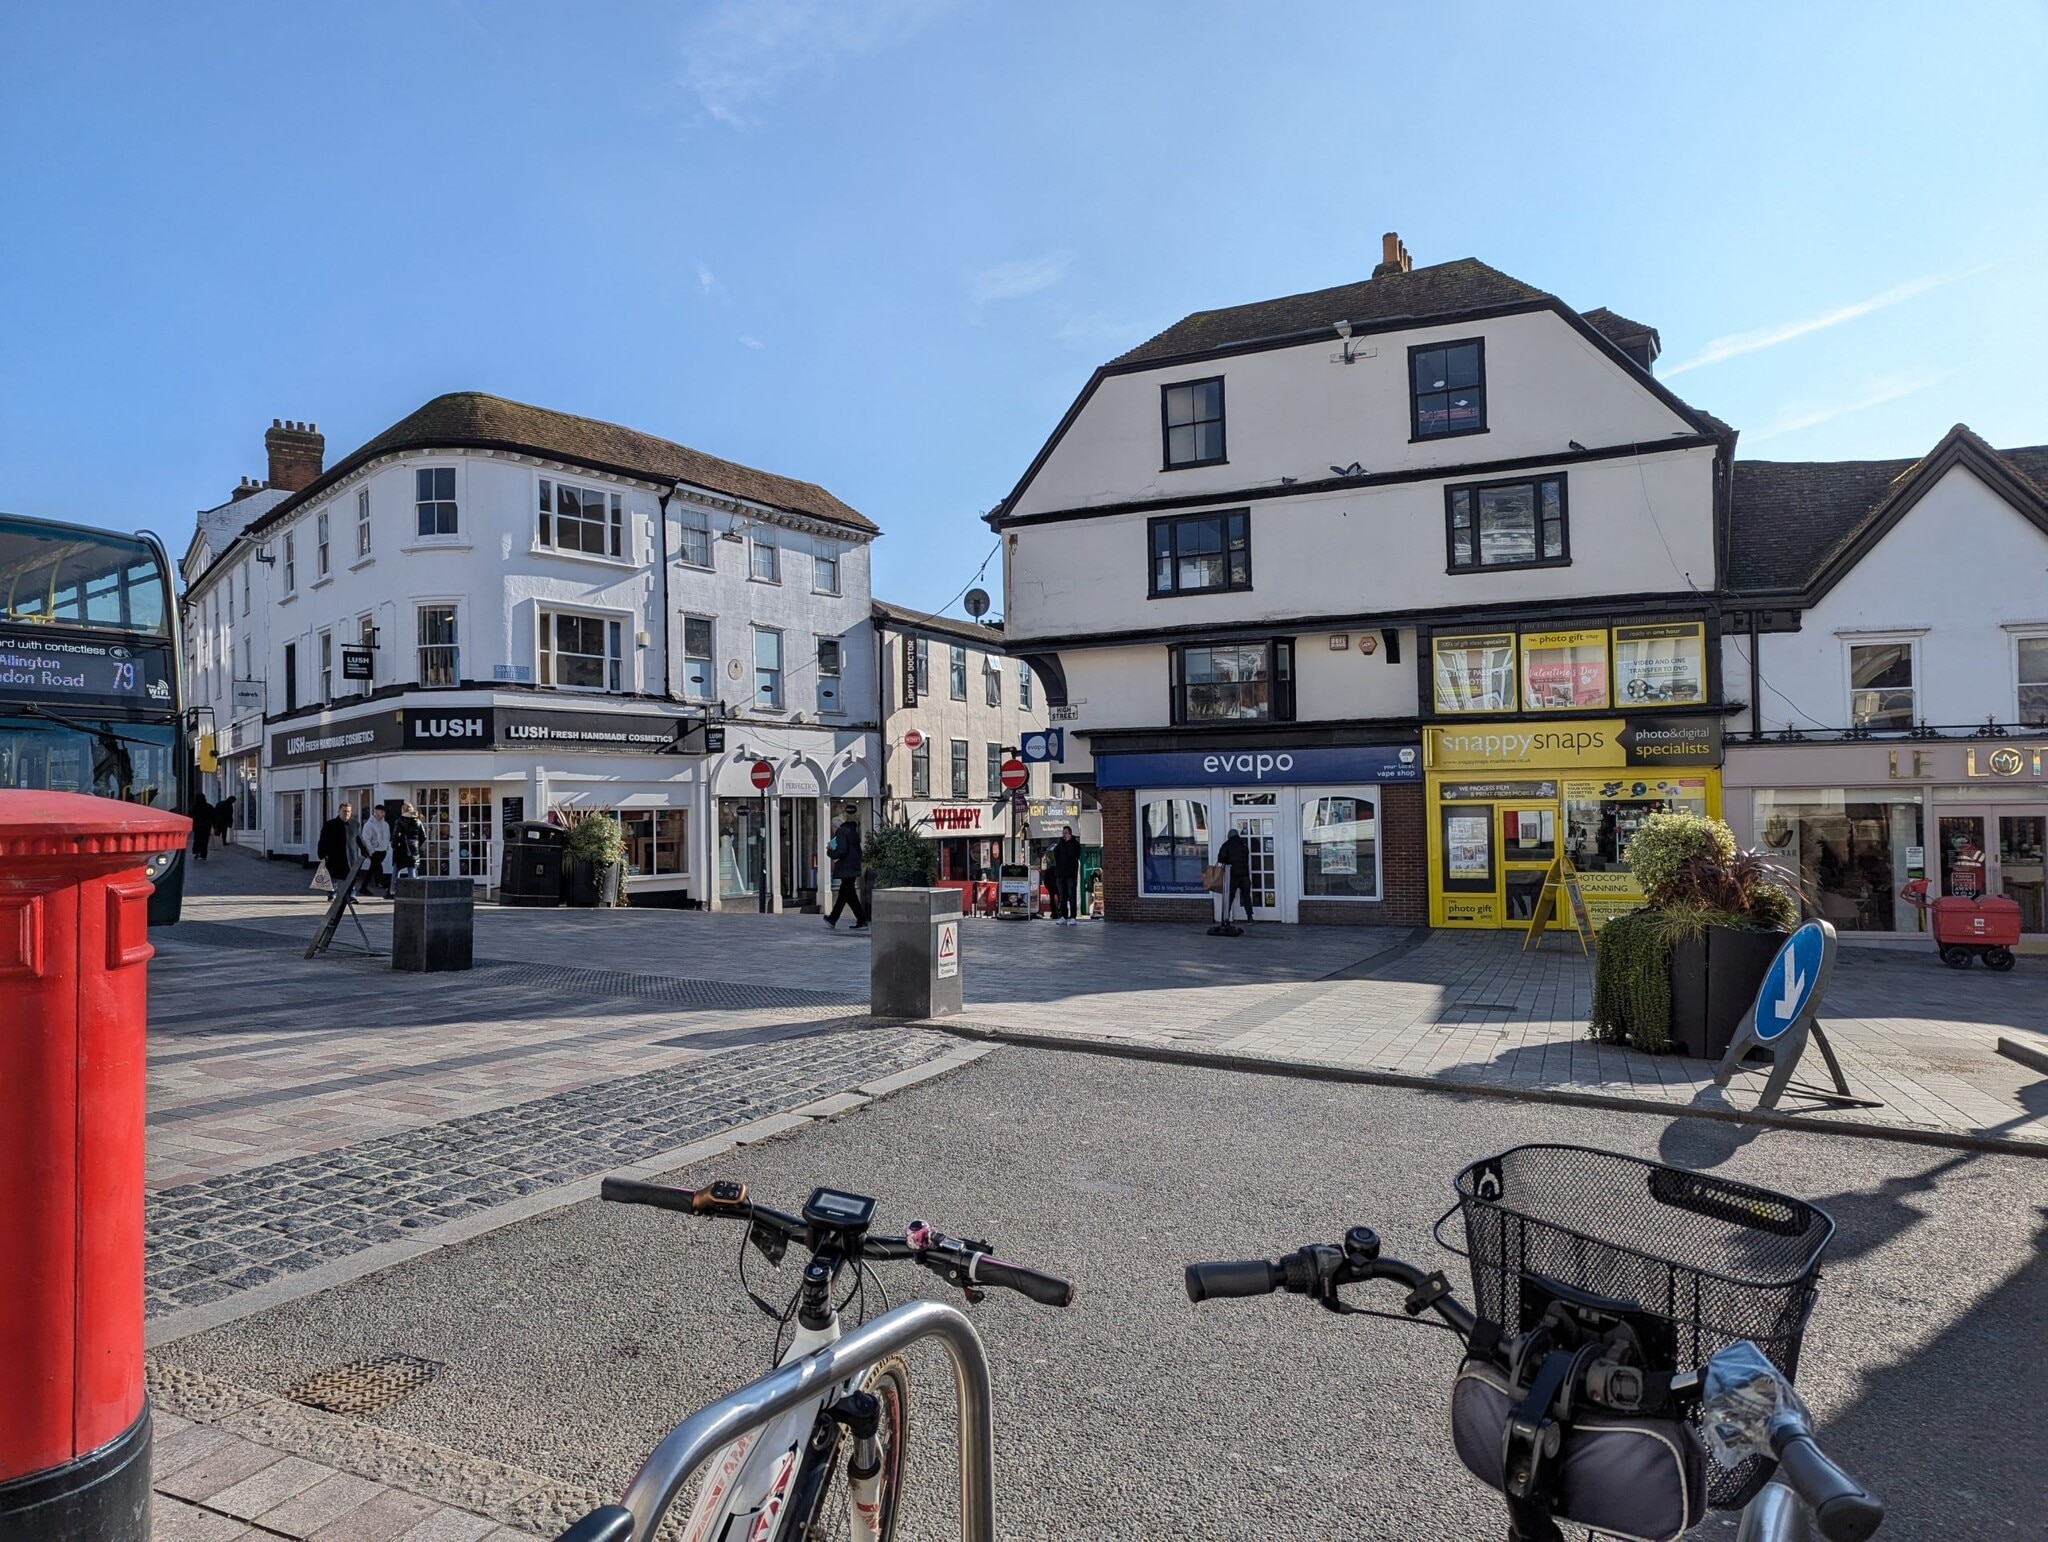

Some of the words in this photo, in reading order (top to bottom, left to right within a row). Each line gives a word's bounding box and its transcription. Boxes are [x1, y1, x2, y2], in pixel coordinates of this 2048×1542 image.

[1540, 635, 1566, 645] photo
[1568, 634, 1584, 643] gift
[0, 640, 14, 648] rd
[18, 640, 42, 650] with
[44, 643, 106, 656] contactless
[0, 655, 60, 670] Allington
[0, 669, 34, 684] don
[42, 671, 84, 687] Road
[112, 662, 134, 690] 79
[1580, 666, 1600, 678] Day
[148, 688, 168, 696] WiFi
[415, 719, 483, 738] LUSH
[510, 726, 549, 738] LUSH
[550, 730, 579, 739] FRESH
[580, 732, 626, 741] HANDMADE
[628, 734, 674, 743] COSMETICS
[1636, 727, 1710, 742] photo&digital
[287, 736, 306, 754] LUSH
[306, 740, 320, 752] FRESH
[345, 730, 374, 746] COSMETICS
[1636, 742, 1710, 758] specialists
[1204, 754, 1294, 779] evapo
[1889, 750, 1936, 779] LE
[1030, 806, 1044, 816] KENT
[1047, 806, 1064, 816] Unisex
[1066, 806, 1078, 816] HAIR
[1448, 904, 1476, 914] photo
[1477, 904, 1492, 914] gift
